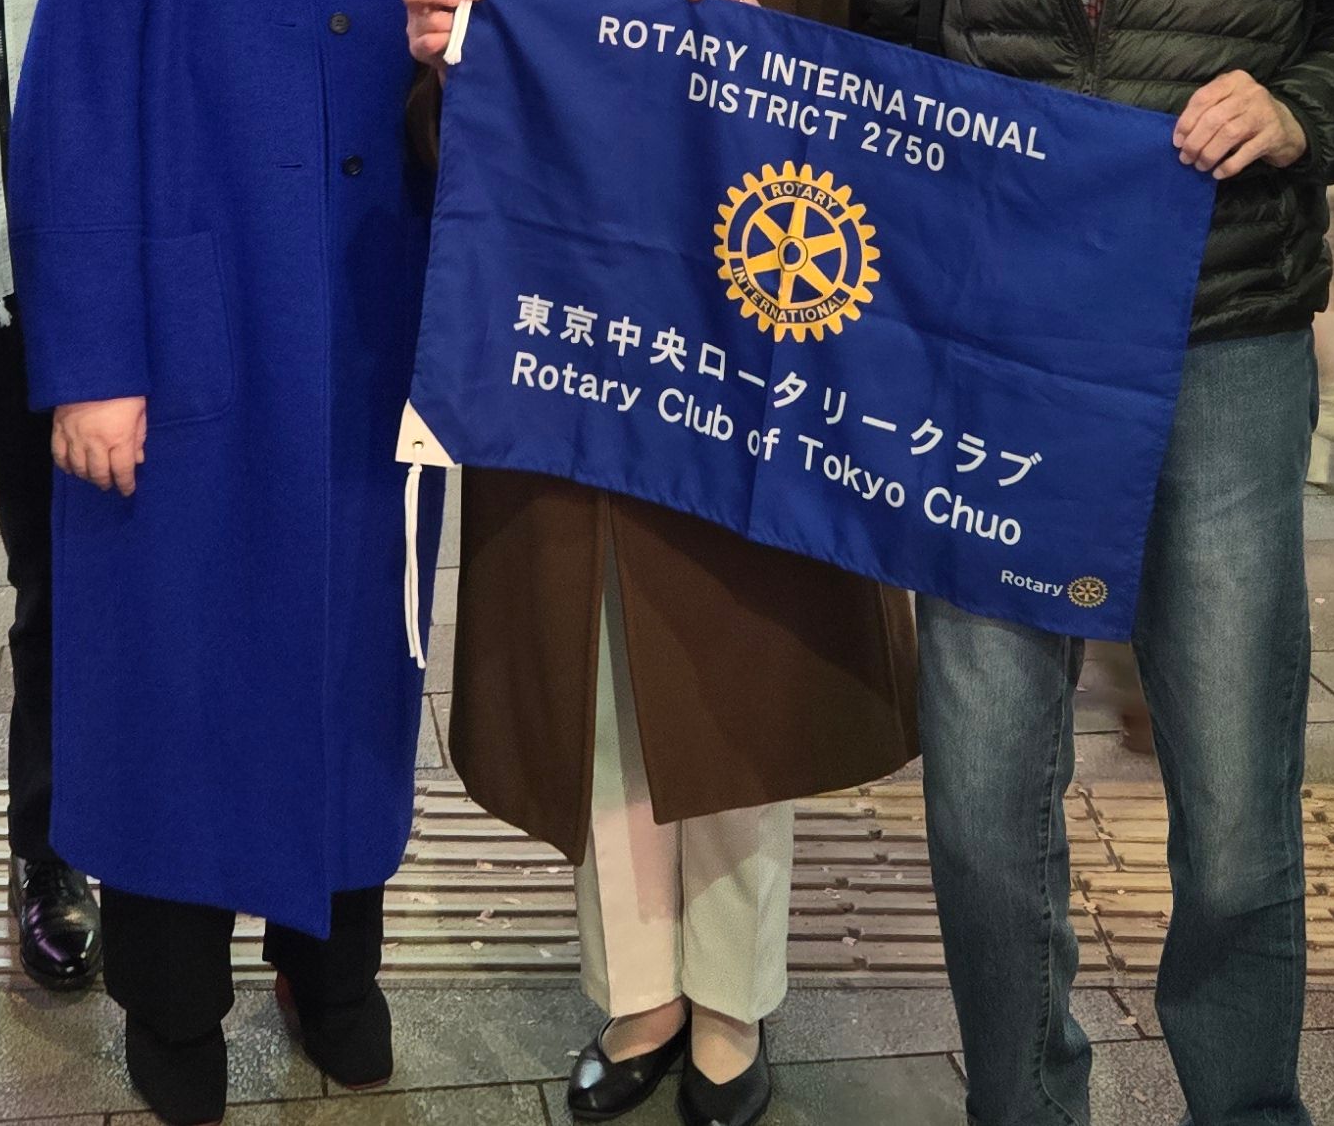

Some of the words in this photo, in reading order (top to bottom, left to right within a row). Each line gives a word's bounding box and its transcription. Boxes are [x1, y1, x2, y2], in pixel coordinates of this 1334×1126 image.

[598, 15, 749, 71] ROTARY
[761, 51, 1047, 160] INTERNATIONAL
[689, 72, 847, 140] DISTRICT
[860, 121, 946, 172] 2750
[770, 182, 838, 211] ROTARY
[732, 266, 847, 323] INTERNATIONAL
[512, 293, 1044, 488] 東京中央ロータリークラブ
[510, 351, 642, 412] Rotary
[657, 388, 734, 442] Club
[747, 427, 780, 462] of
[798, 435, 906, 509] Tokyo
[923, 486, 1022, 546] Chuo
[1000, 569, 1064, 597] Rotary
